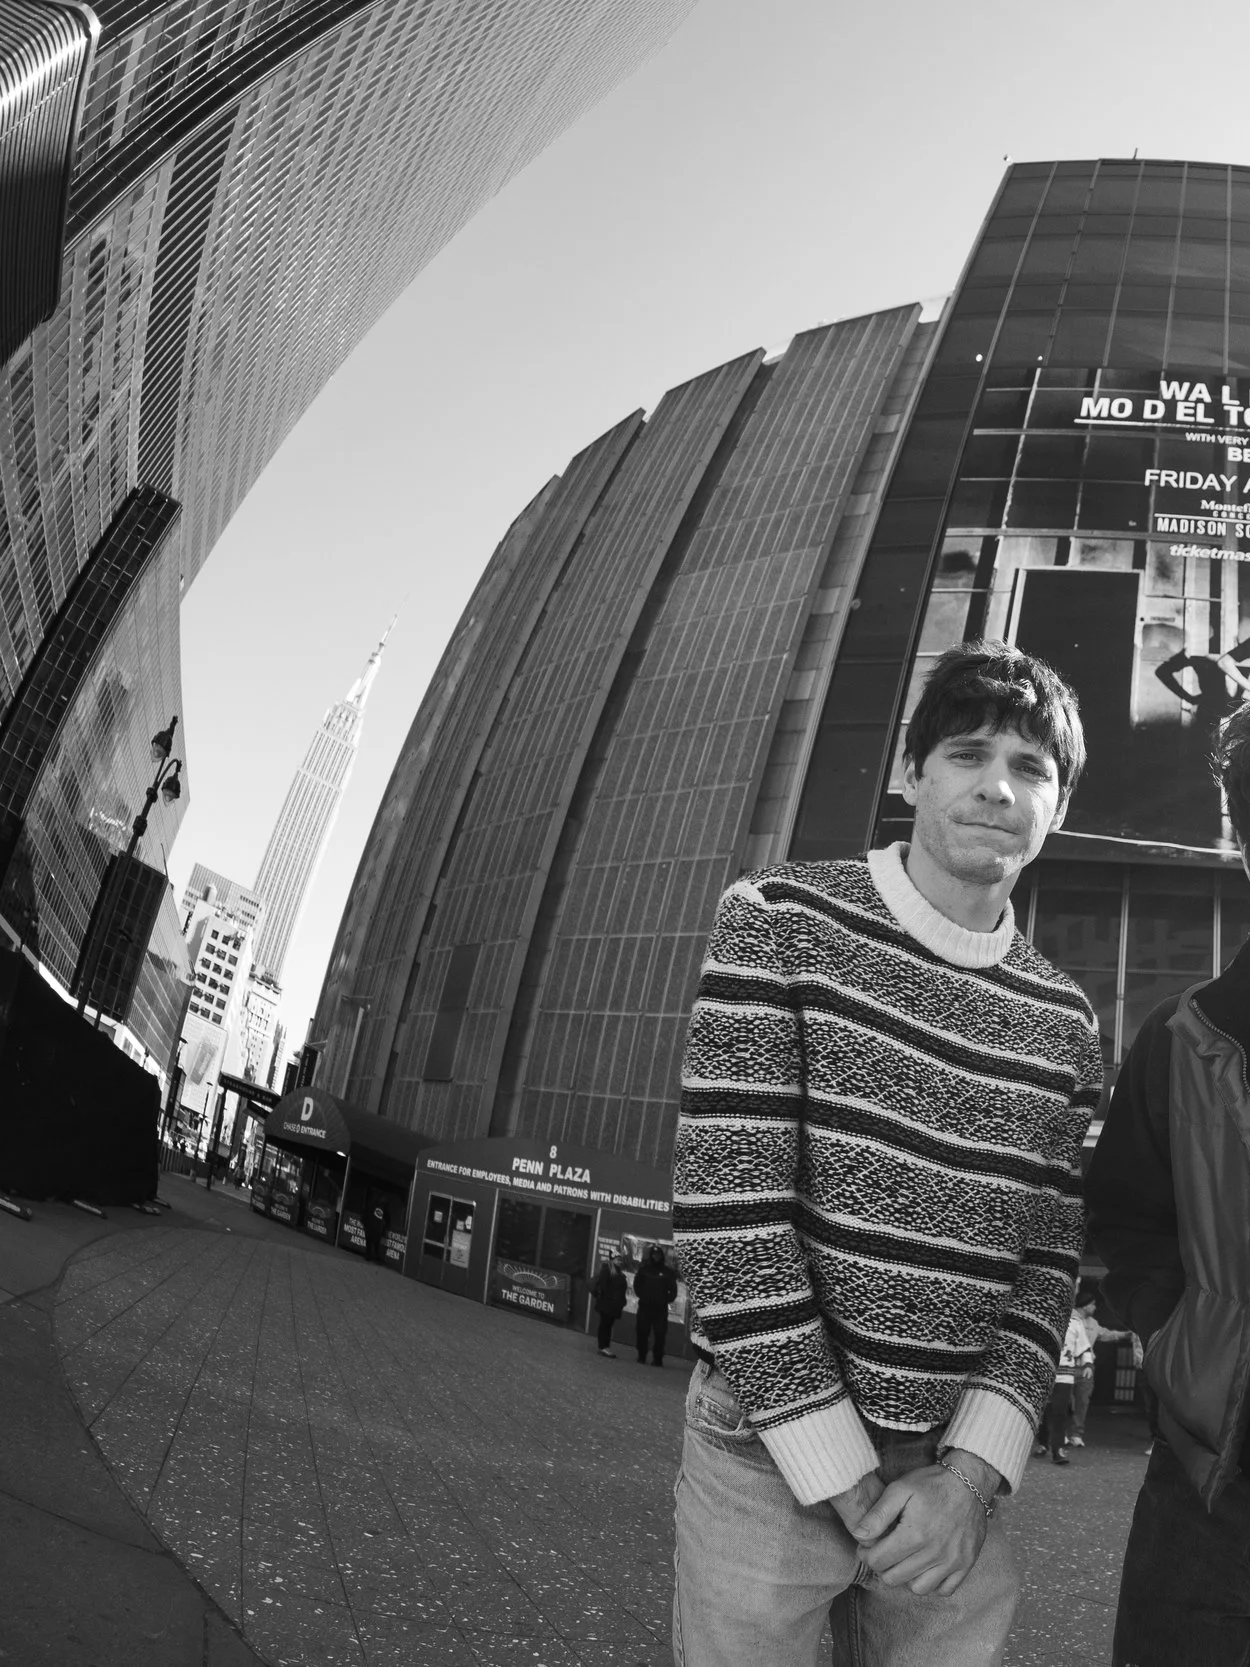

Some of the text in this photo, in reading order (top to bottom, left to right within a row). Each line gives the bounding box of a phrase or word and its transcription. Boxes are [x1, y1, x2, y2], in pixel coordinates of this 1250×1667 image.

[1080, 397, 1214, 423] MODEL
[1185, 432, 1216, 443] WITH
[1217, 434, 1249, 446] VERY
[1144, 469, 1238, 492] FRIDAY
[1157, 517, 1226, 536] MADISON
[301, 1096, 314, 1121] D
[300, 1125, 326, 1139] ENTRANCE
[549, 1145, 557, 1159] 8
[512, 1157, 591, 1183] PENN PLAZA
[427, 1159, 670, 1212] ENTRANCE FOR EMPLOYEES, MEDIA AND PATRONS WITH DISABILITIES
[501, 1288, 554, 1313] THE GARDEN
